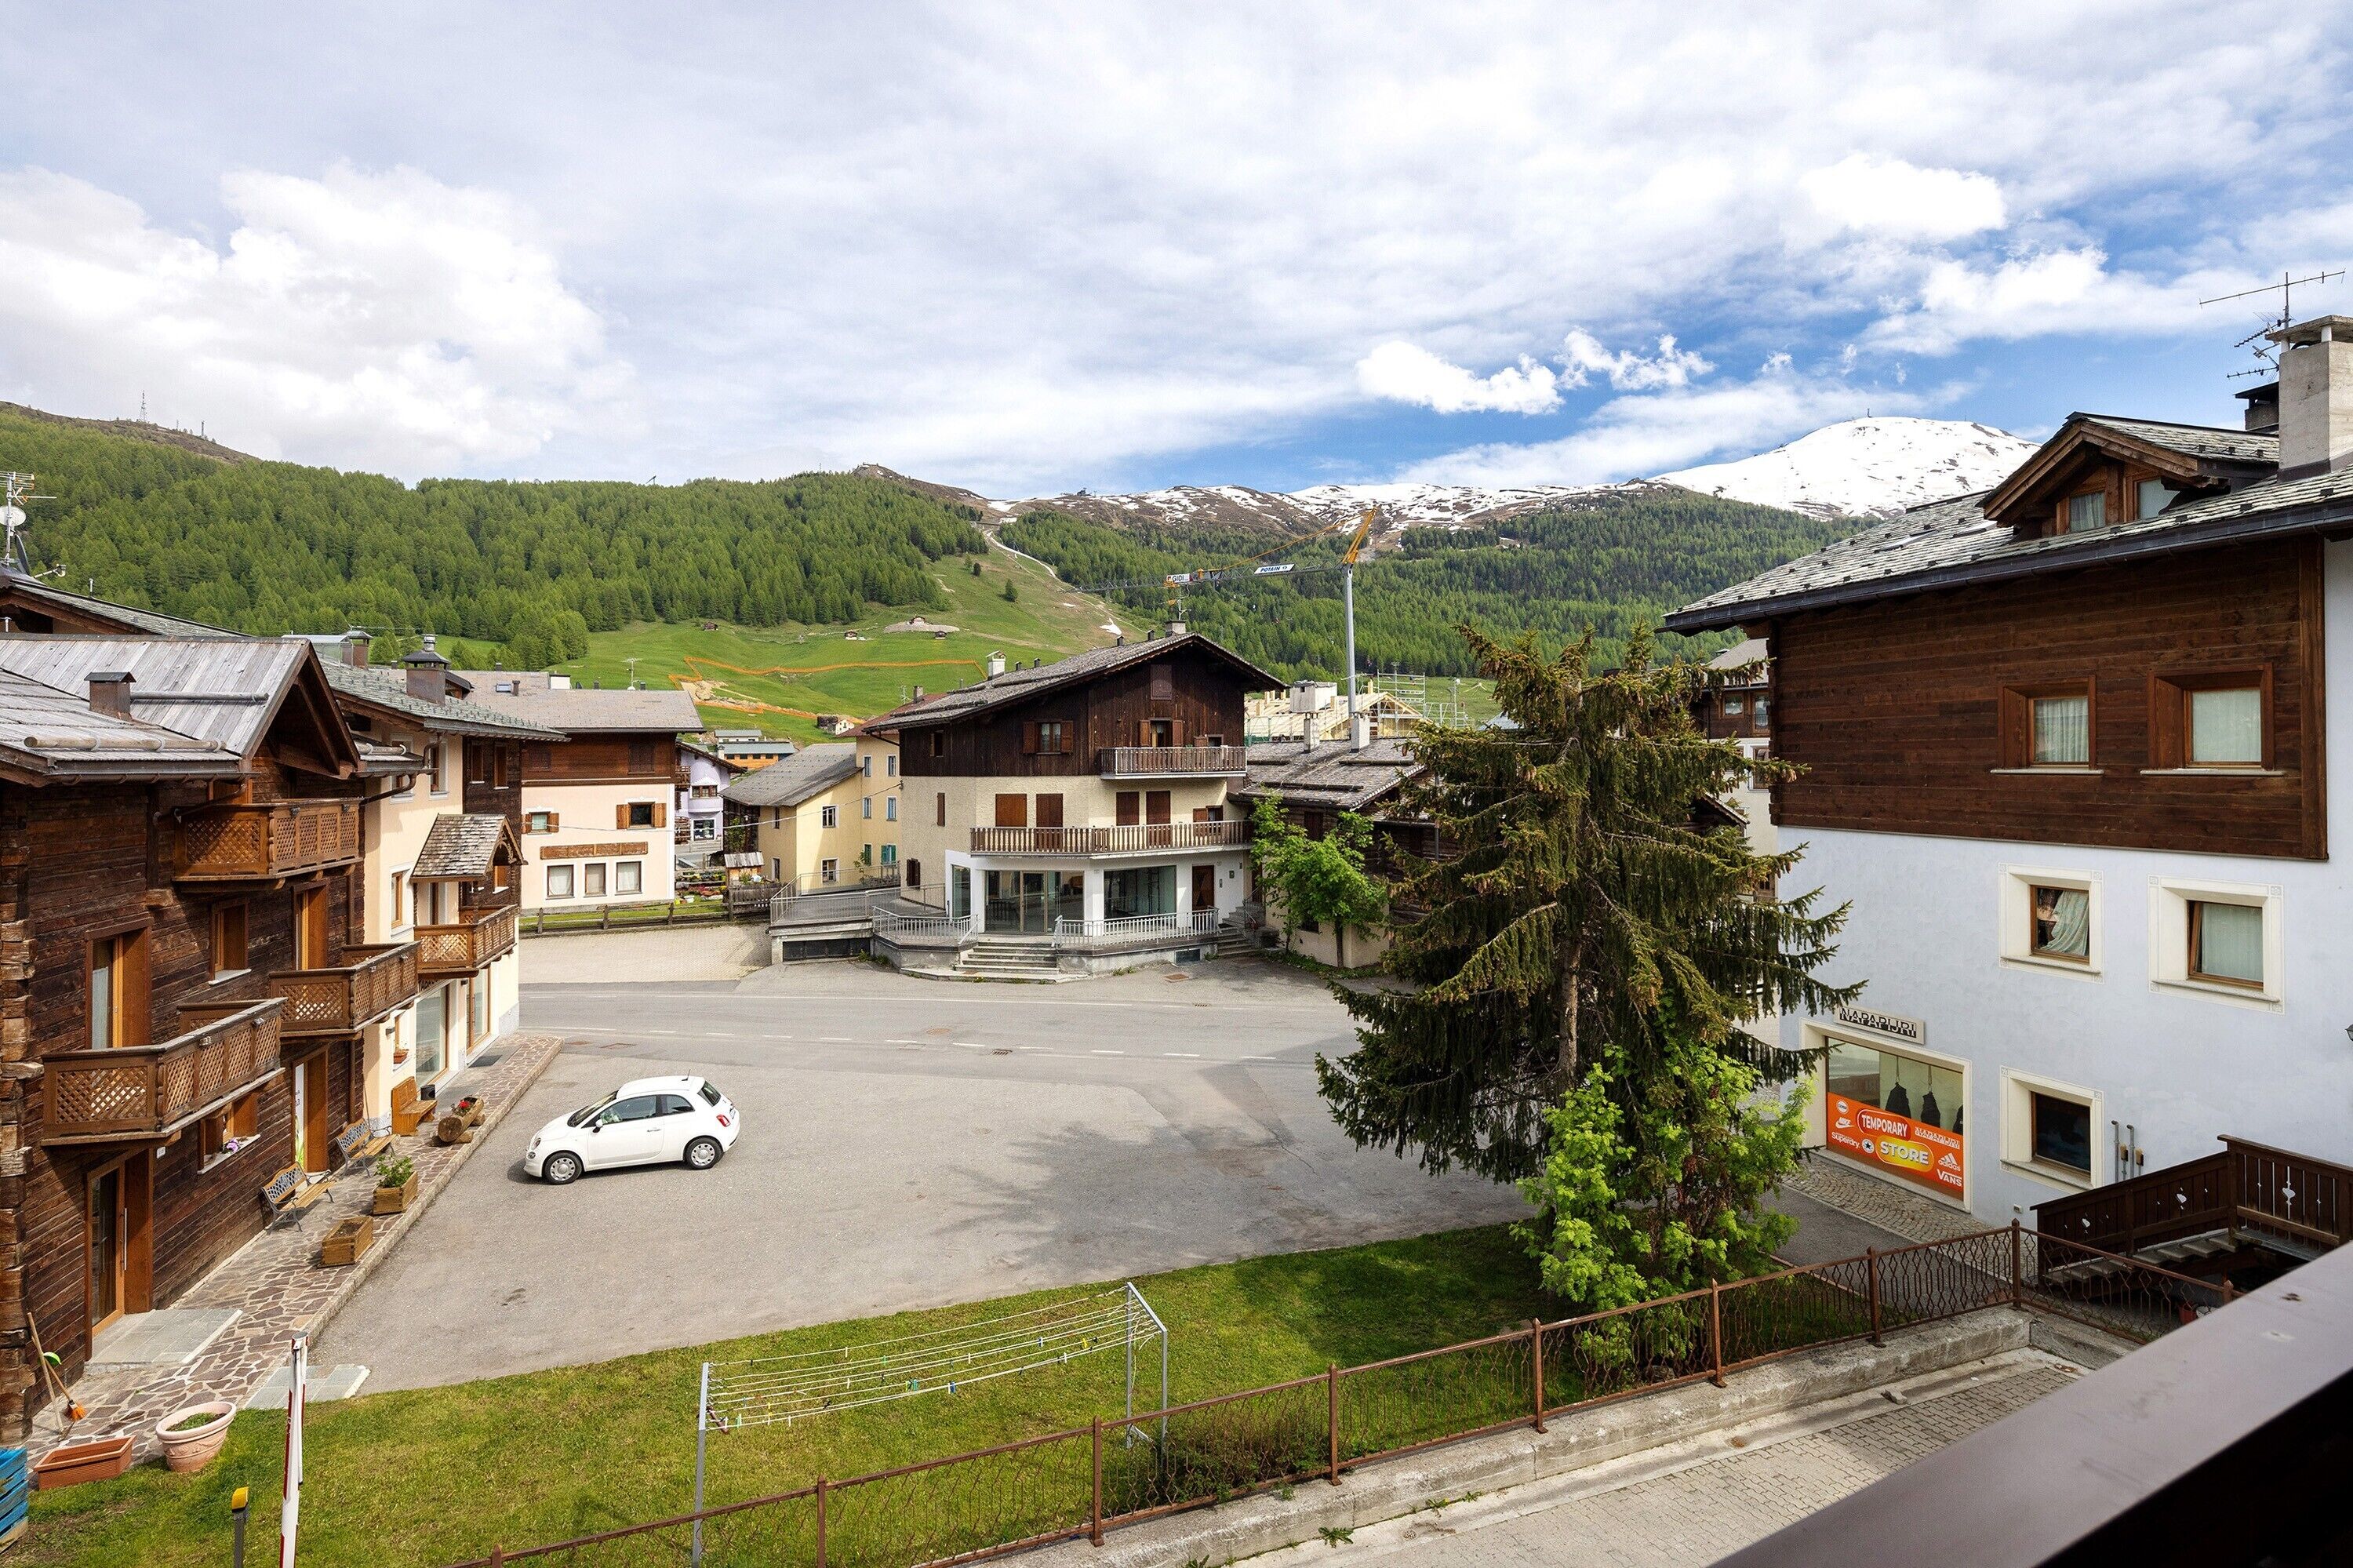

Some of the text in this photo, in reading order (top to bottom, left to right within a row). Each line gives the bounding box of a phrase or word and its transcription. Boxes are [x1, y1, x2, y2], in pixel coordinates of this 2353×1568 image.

[1861, 1114, 1908, 1137] TEMPORARY
[1880, 1141, 1929, 1165] STORE
[1937, 1168, 1962, 1187] VANS
